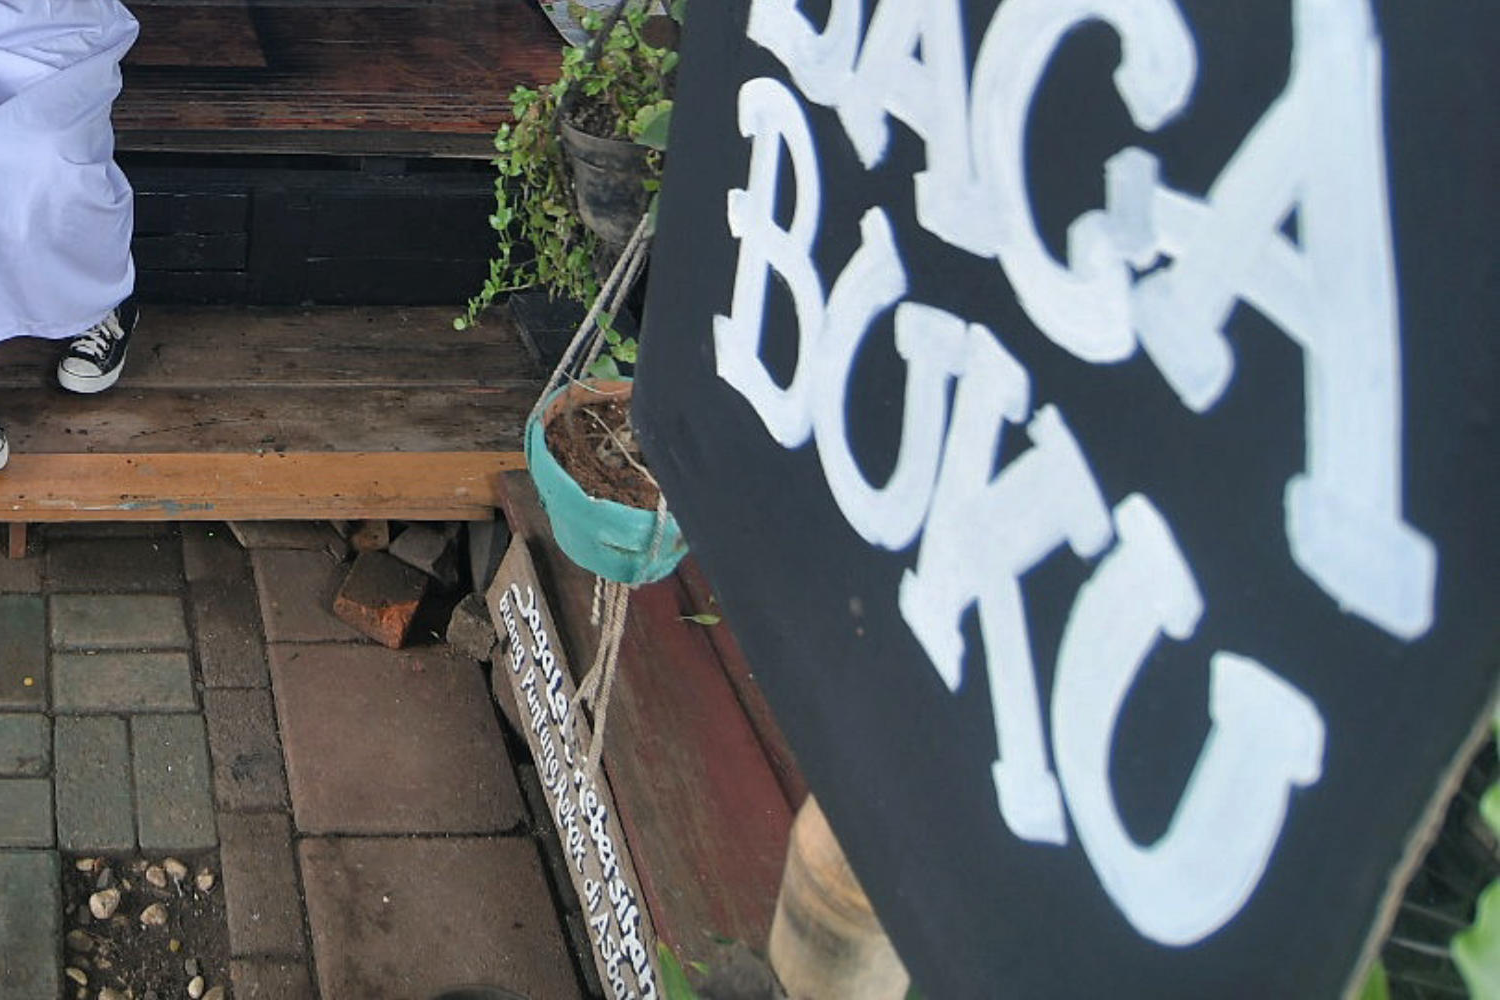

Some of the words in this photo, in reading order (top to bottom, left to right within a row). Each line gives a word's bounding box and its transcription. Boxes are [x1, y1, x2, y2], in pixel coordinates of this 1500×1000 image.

[714, 77, 1325, 946] BUKU
[500, 591, 525, 672] buang
[584, 879, 602, 912] di
[589, 913, 636, 1000] Asba
